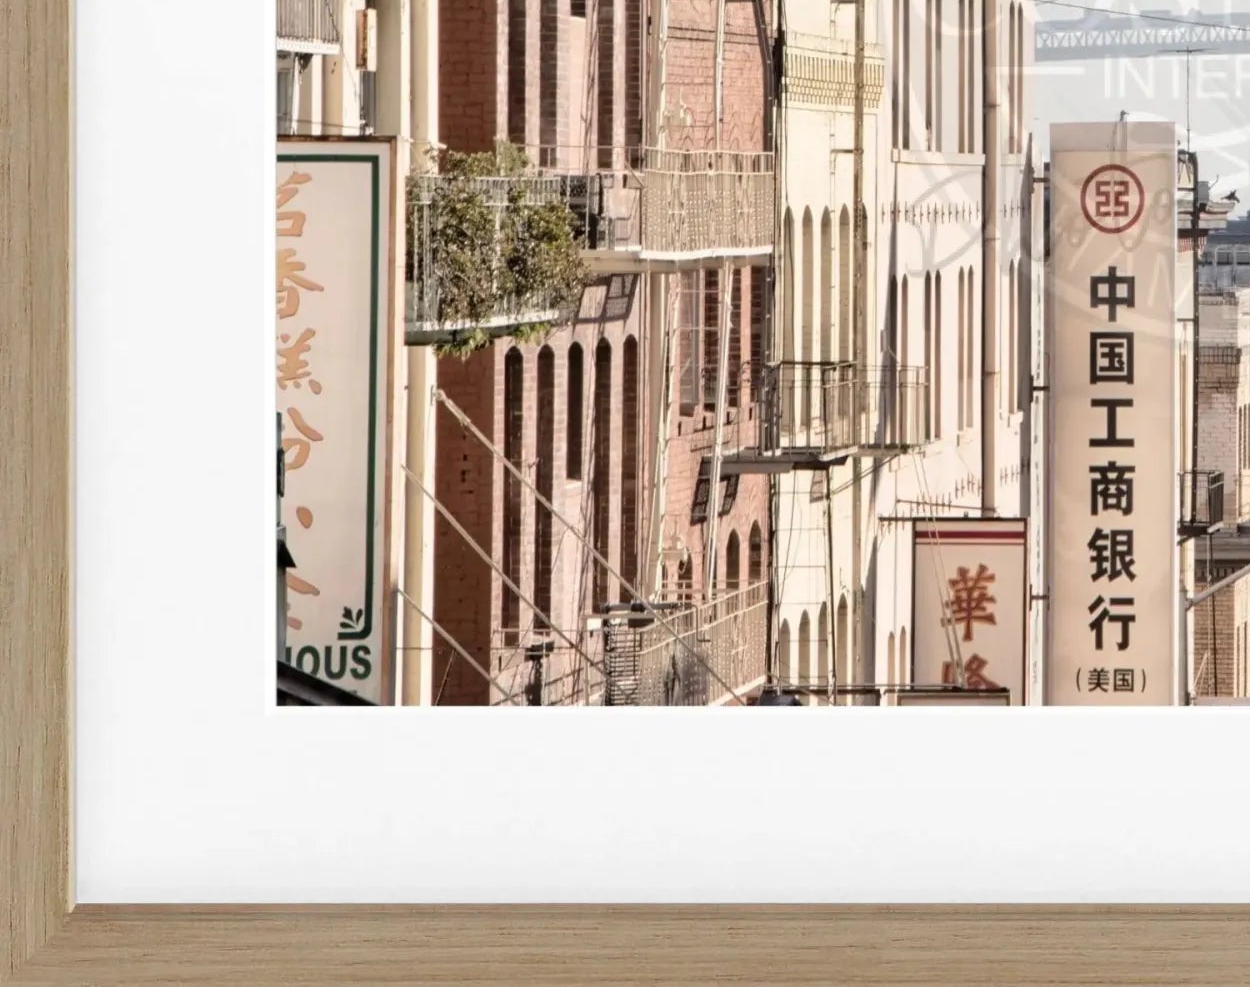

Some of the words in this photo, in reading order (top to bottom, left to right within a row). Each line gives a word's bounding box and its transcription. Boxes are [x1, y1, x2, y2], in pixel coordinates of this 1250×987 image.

[1087, 266, 1136, 651] 中国工商银行
